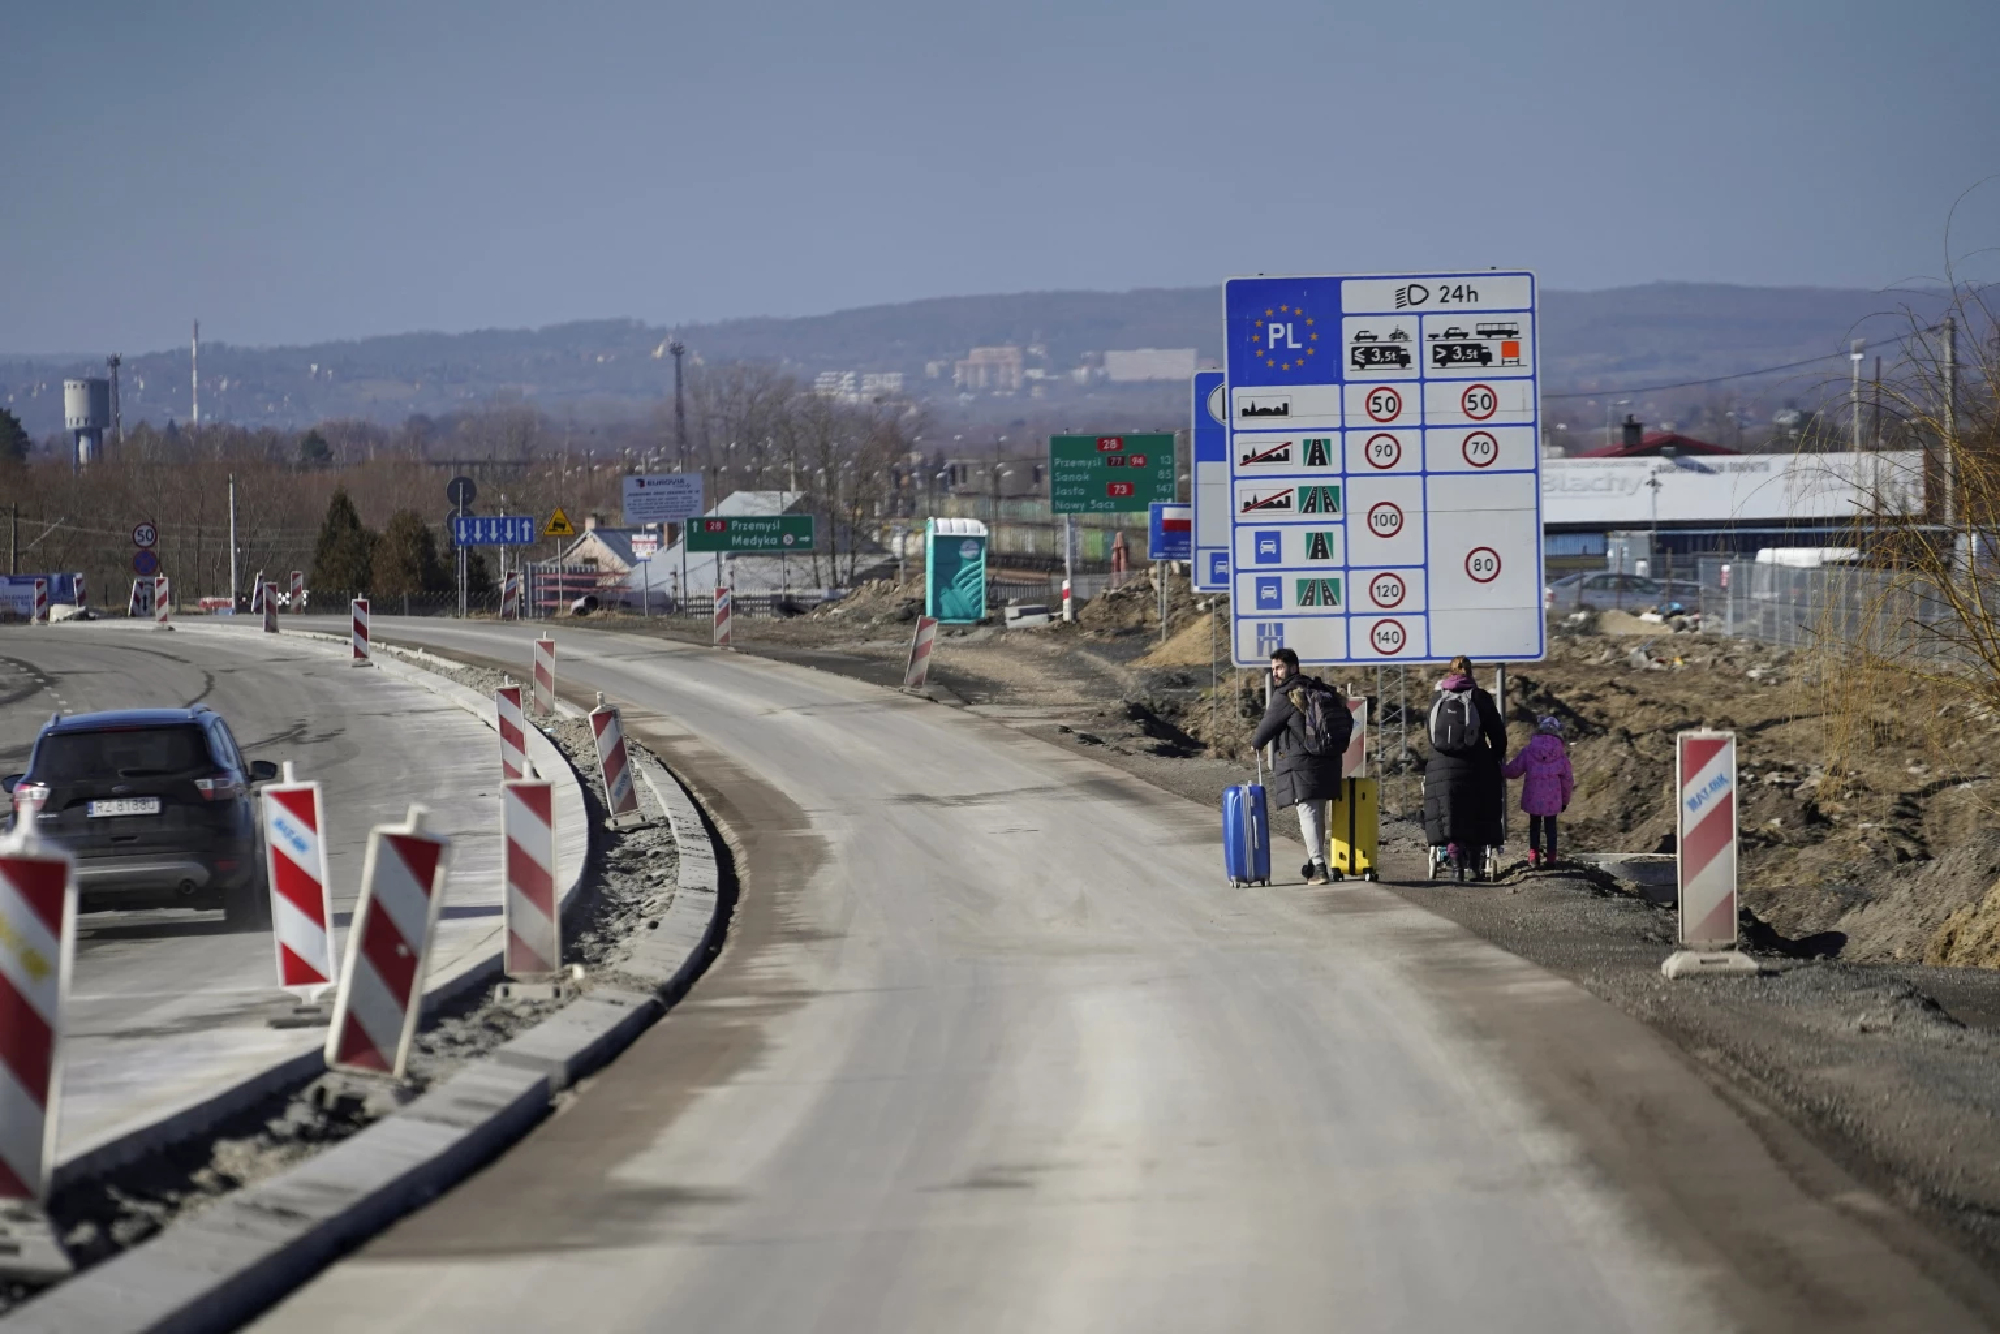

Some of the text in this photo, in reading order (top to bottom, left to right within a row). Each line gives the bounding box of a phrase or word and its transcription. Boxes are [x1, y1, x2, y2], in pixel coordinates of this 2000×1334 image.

[1440, 284, 1479, 303] 24h
[1268, 322, 1303, 350] PL
[1371, 395, 1397, 414] 50
[1467, 392, 1493, 411] 50
[1103, 439, 1119, 450] 28
[1374, 443, 1393, 458] 90
[1471, 441, 1491, 456] 70
[1054, 471, 1091, 482] Sanok
[1156, 483, 1174, 494] 147
[710, 521, 722, 531] 28
[1373, 514, 1399, 527] 100
[137, 529, 155, 543] 50
[731, 534, 779, 548] Medyka
[1474, 558, 1494, 572] 80
[1375, 584, 1400, 598] 120
[1376, 632, 1400, 645] 140
